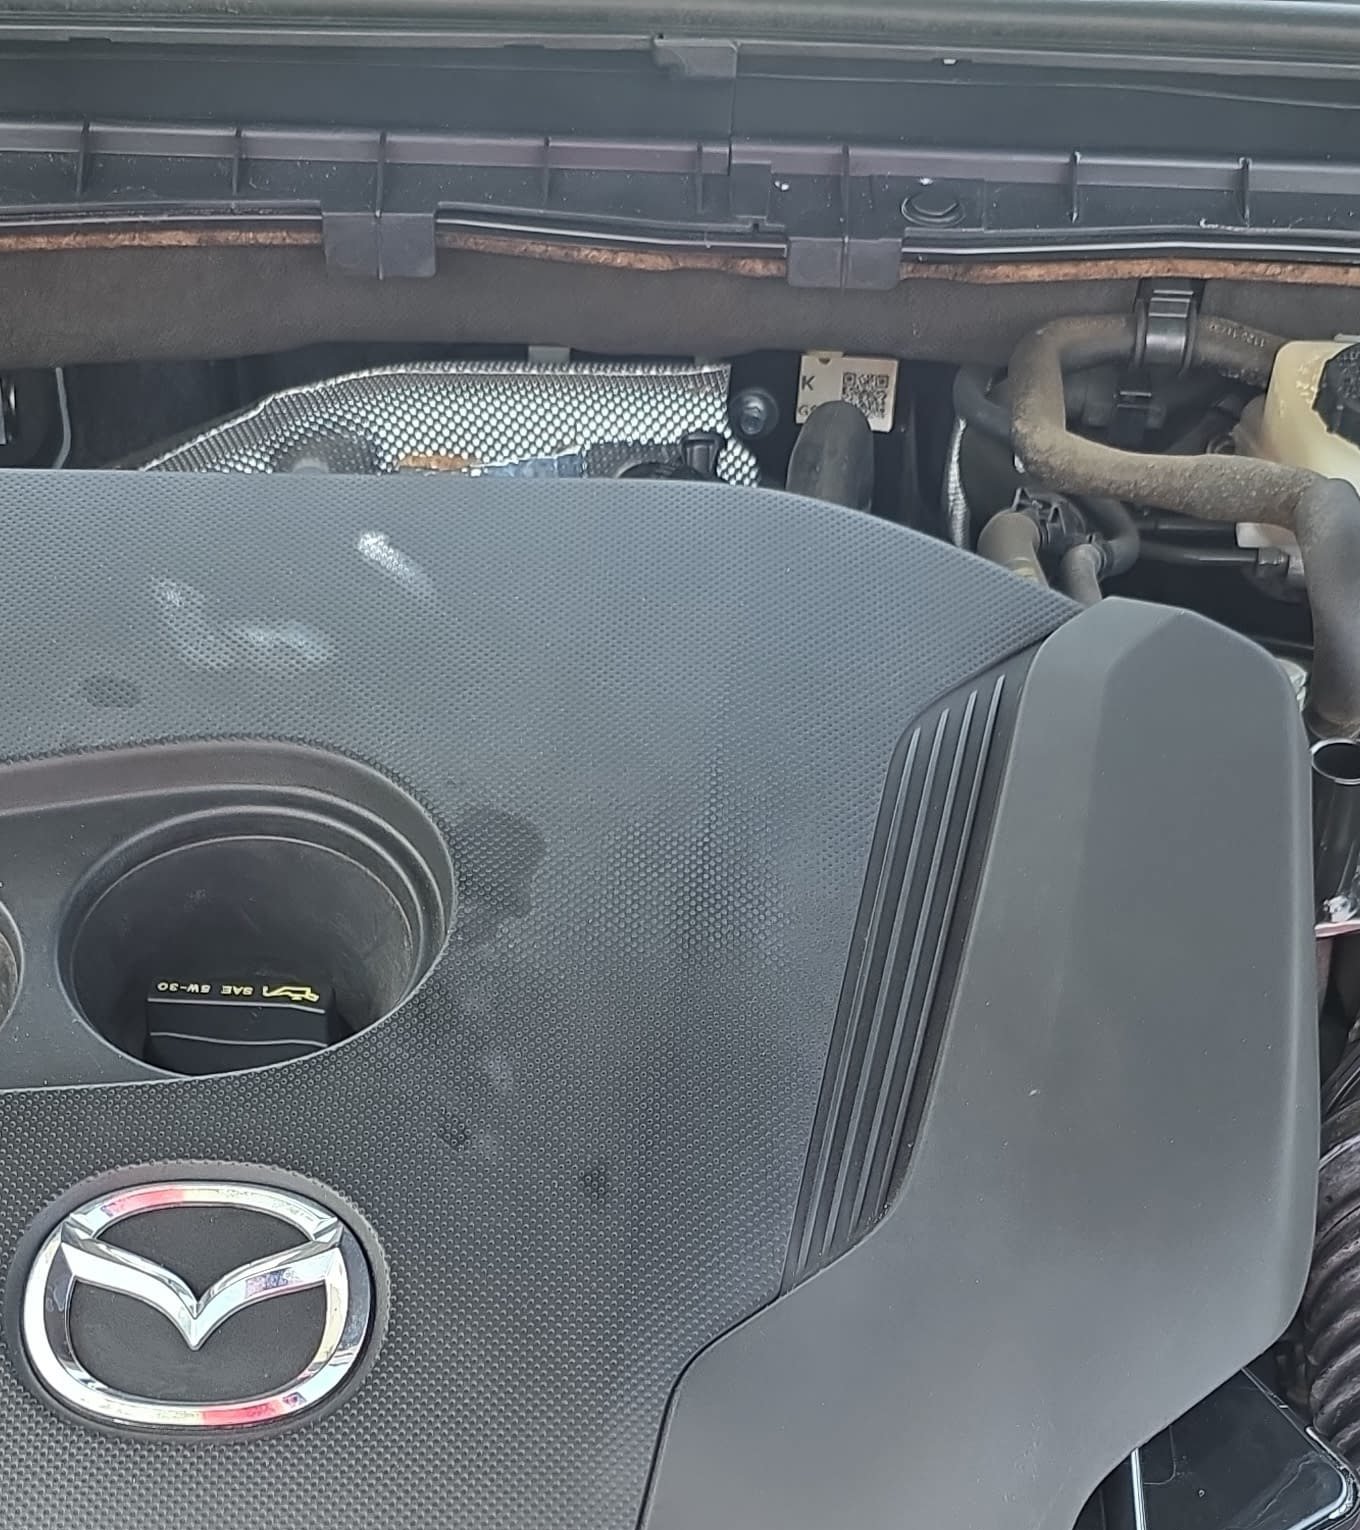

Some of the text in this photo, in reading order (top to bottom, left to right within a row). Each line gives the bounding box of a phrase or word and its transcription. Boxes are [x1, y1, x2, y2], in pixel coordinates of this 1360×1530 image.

[801, 375, 816, 391] K
[157, 981, 254, 995] SAE 5W-30
